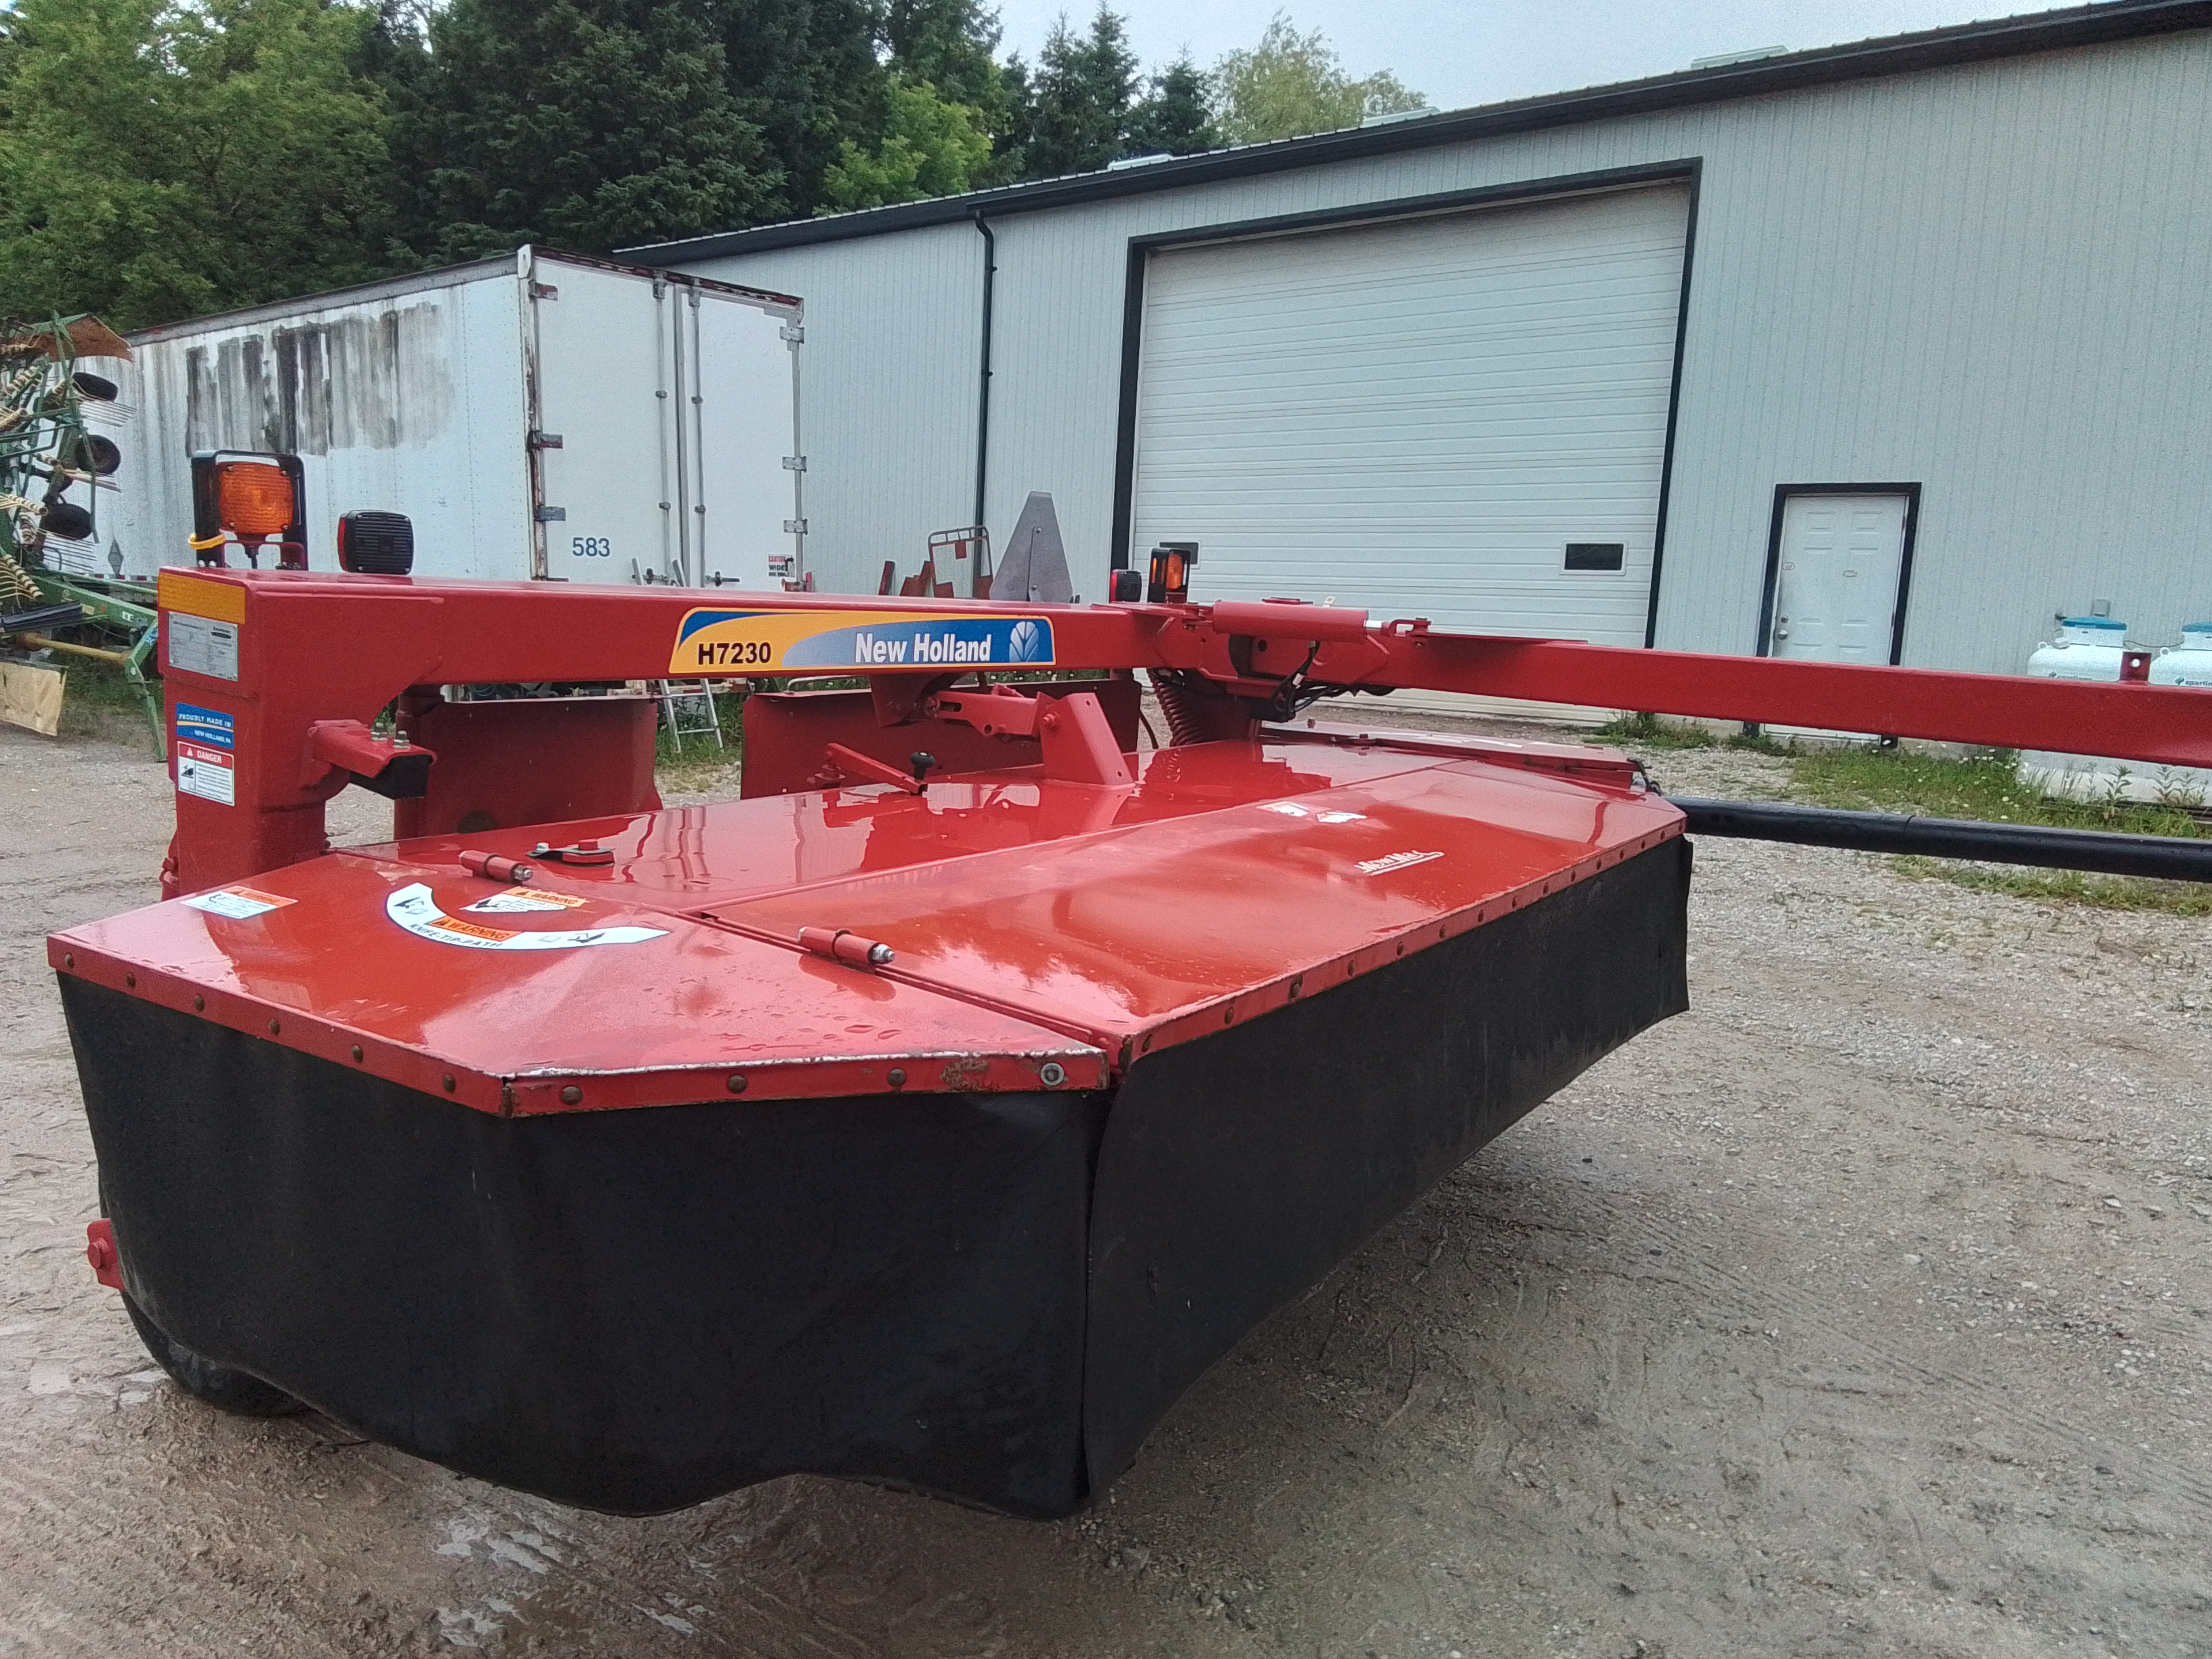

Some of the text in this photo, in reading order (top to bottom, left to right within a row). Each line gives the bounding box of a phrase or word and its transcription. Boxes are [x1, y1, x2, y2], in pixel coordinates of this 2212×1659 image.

[572, 537, 611, 557] 583
[698, 642, 771, 665] H7230
[855, 632, 992, 663] New Holland
[178, 713, 205, 722] PROUDLY
[206, 716, 223, 726] MADE
[197, 750, 222, 764] DANGER
[447, 921, 510, 940] WARNING
